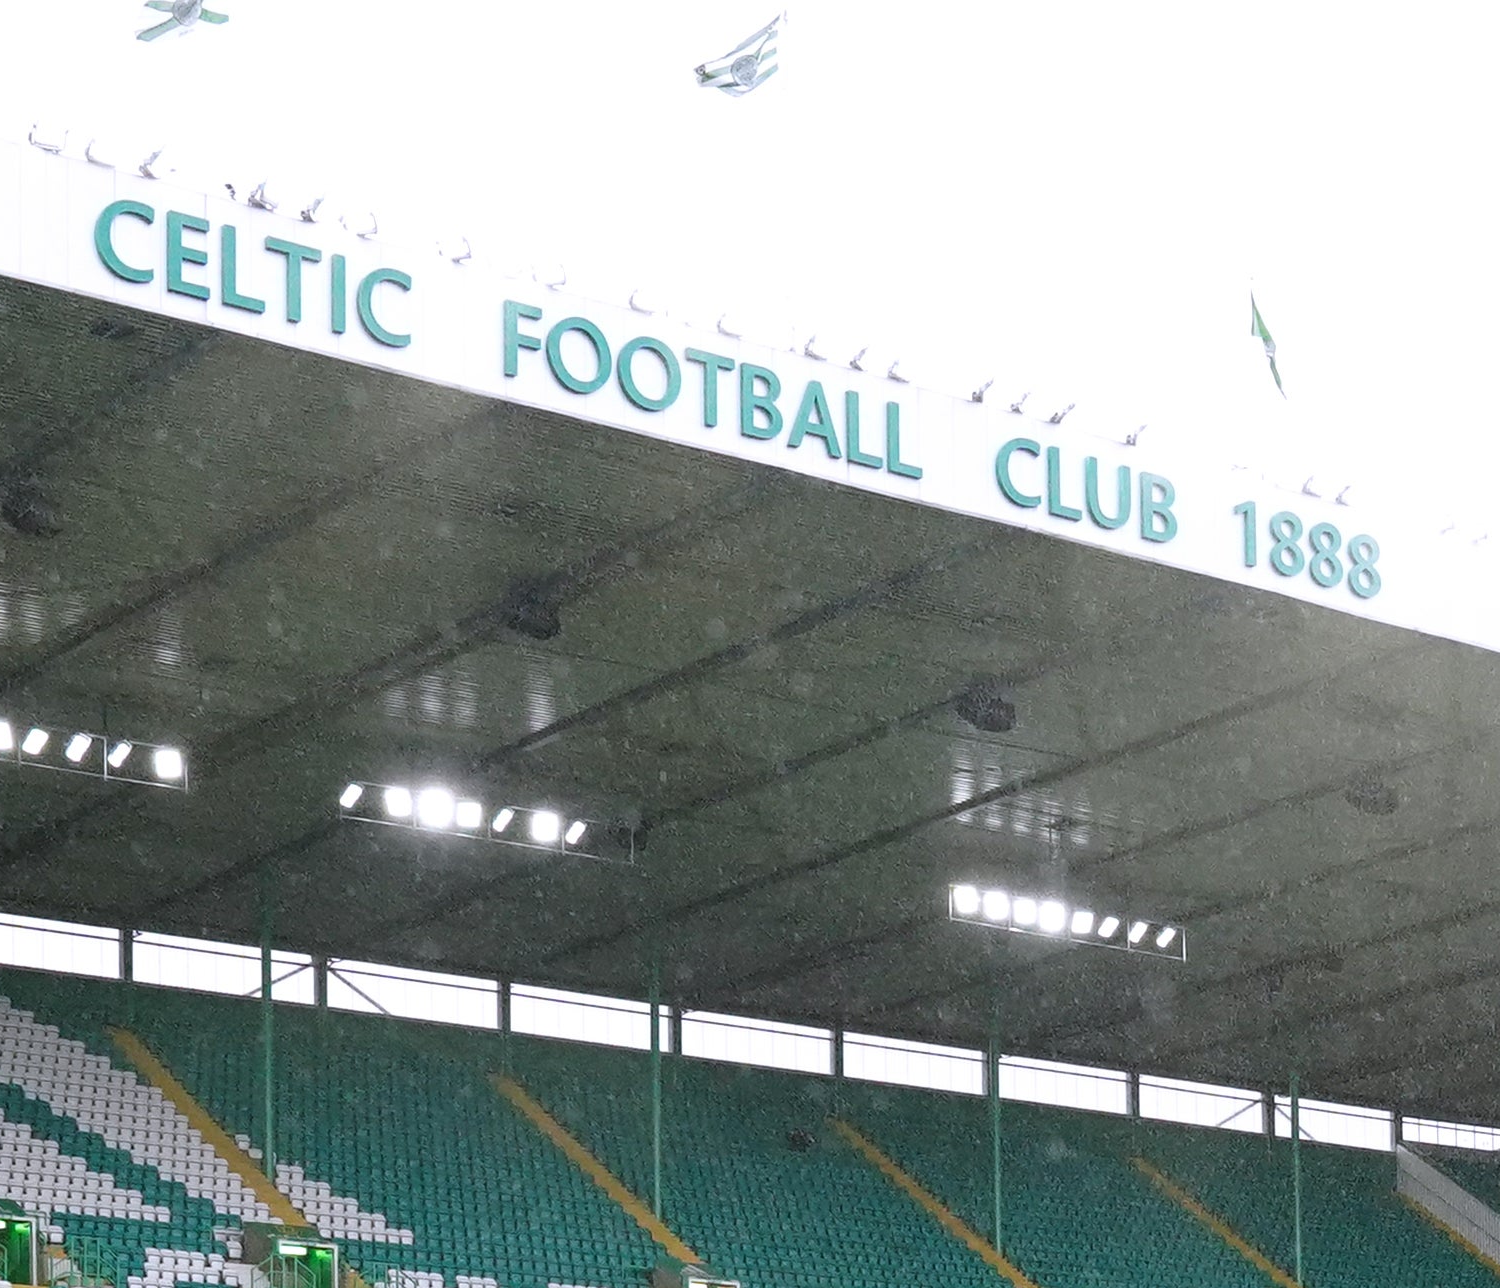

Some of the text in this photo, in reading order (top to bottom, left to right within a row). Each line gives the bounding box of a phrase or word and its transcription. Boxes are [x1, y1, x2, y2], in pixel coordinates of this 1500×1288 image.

[92, 199, 1383, 598] CELTIC FOOTBALL CLUB 1888
